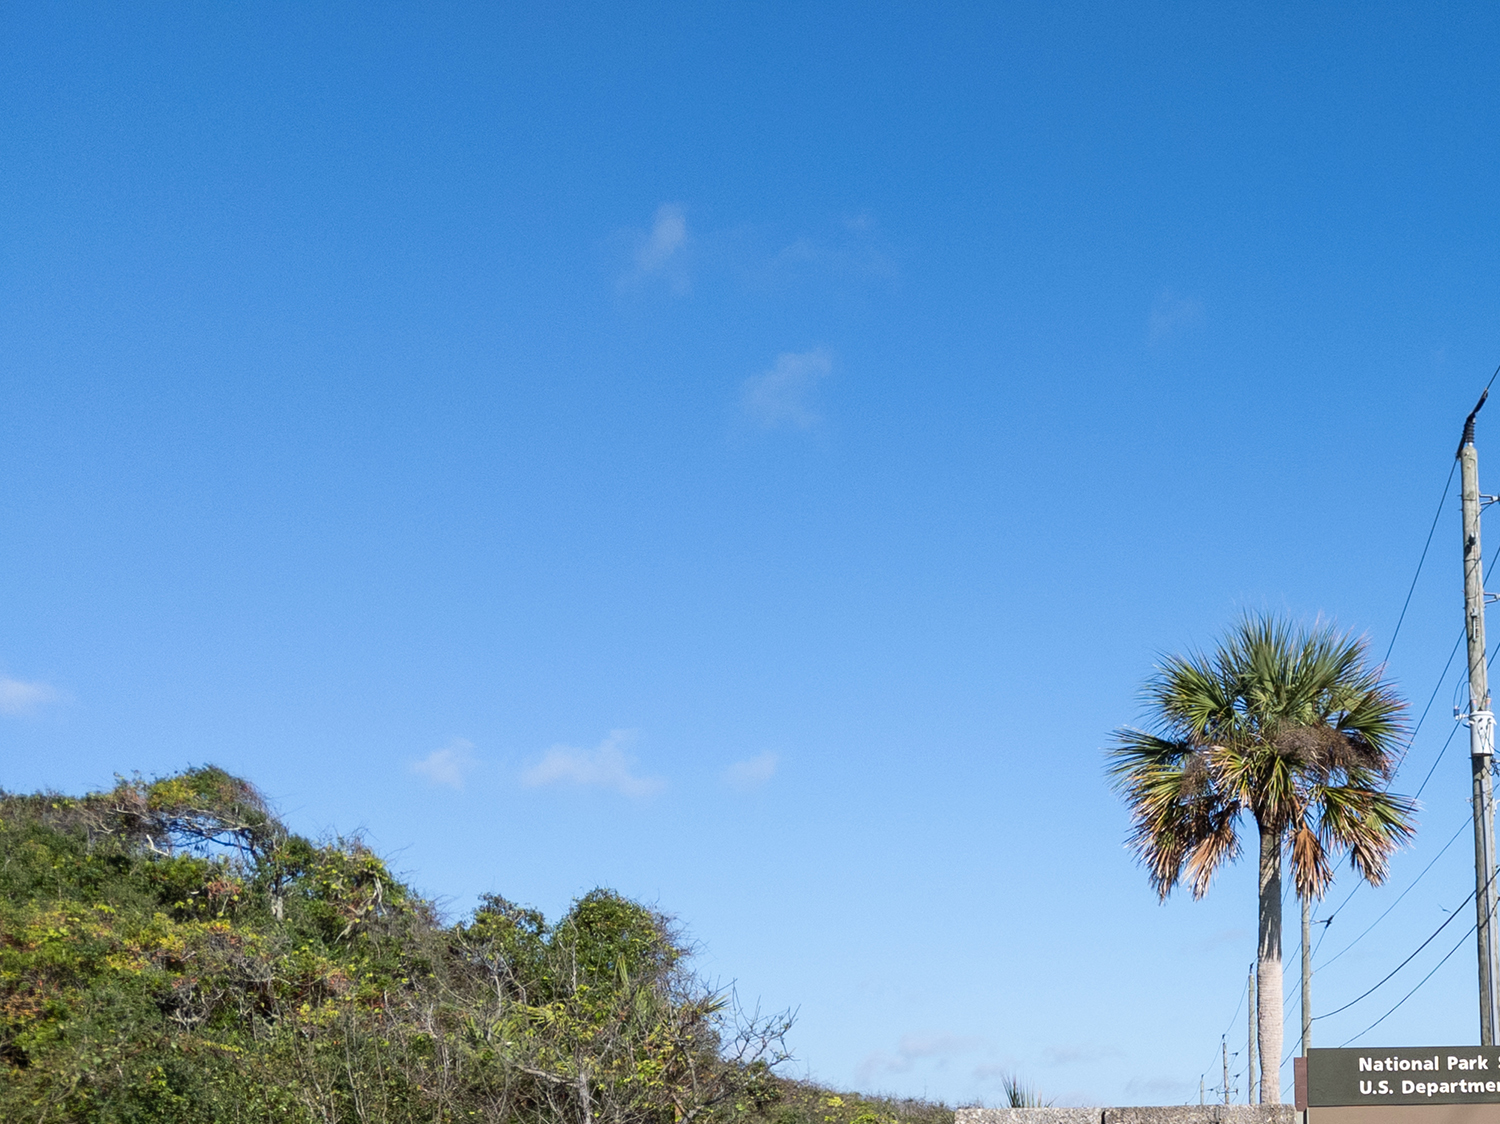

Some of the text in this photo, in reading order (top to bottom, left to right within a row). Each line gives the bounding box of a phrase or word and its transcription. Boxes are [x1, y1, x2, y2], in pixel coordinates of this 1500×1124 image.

[1358, 1056, 1440, 1072] National
[1447, 1055, 1489, 1071] Park
[1359, 1080, 1394, 1095] U.S.
